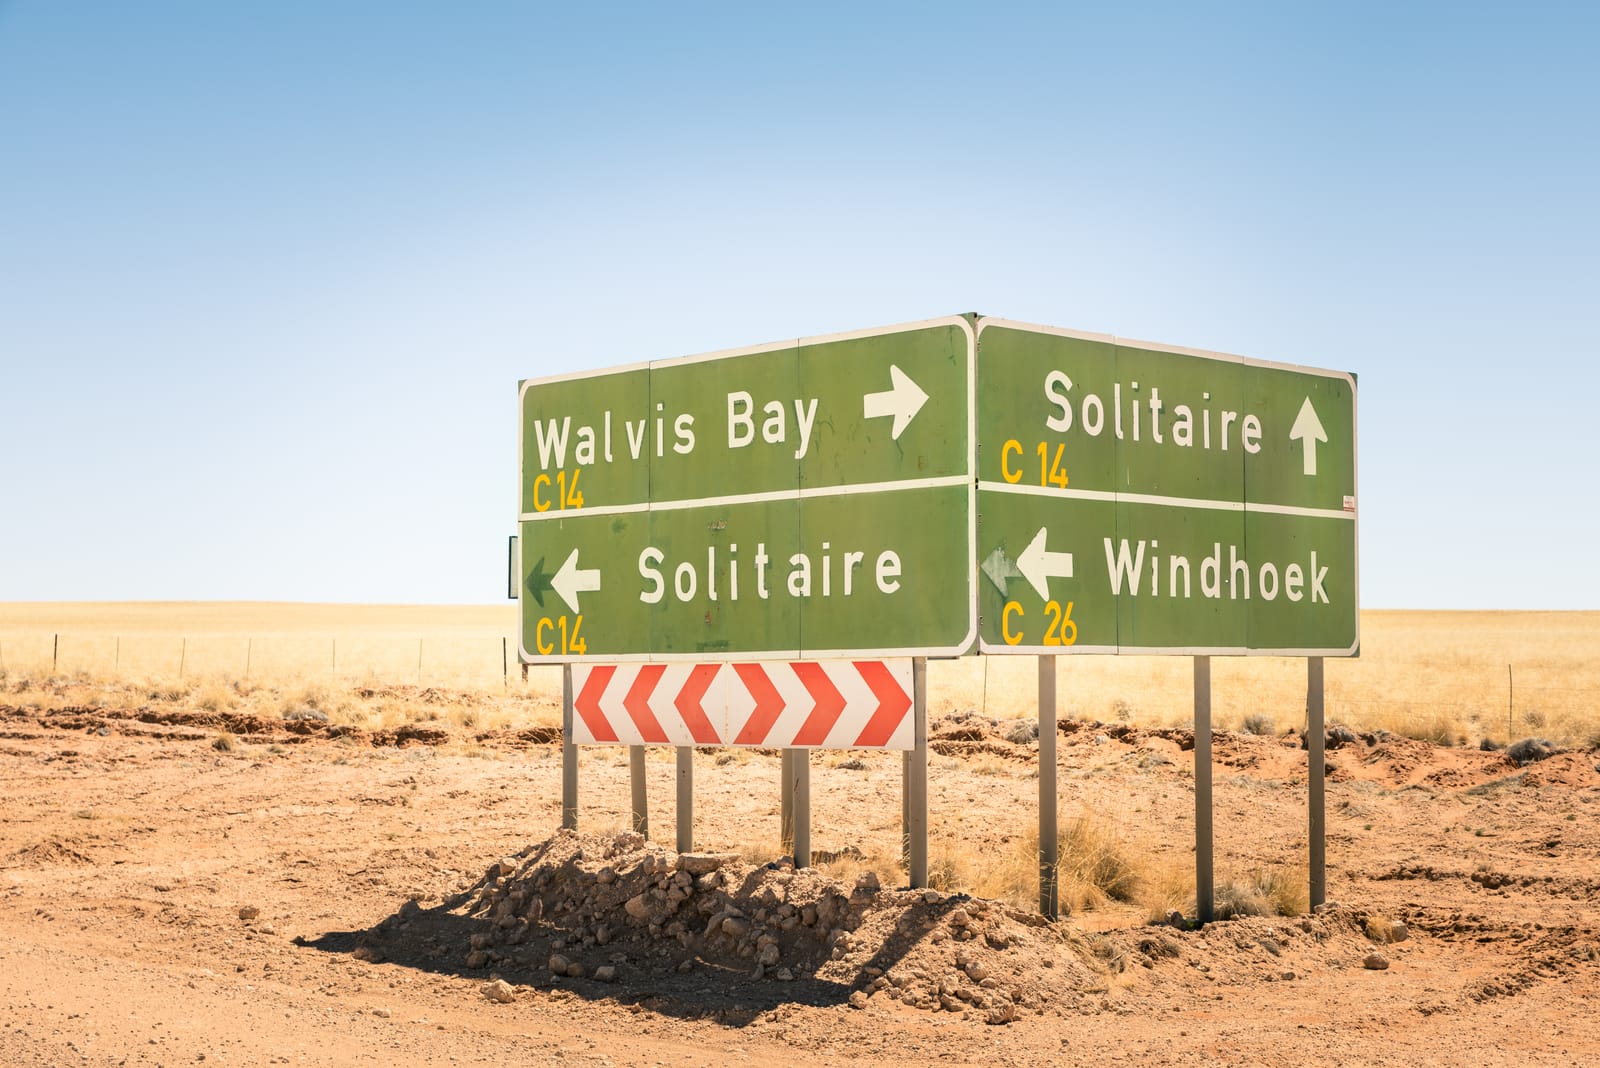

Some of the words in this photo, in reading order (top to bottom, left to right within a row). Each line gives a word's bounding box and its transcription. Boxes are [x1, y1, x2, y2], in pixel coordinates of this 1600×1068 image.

[534, 403, 695, 470] Walvis
[727, 390, 818, 459] Bay
[1044, 370, 1262, 454] Solitaire
[638, 542, 902, 603] Solitaire
[1104, 538, 1329, 604] Windhoek
